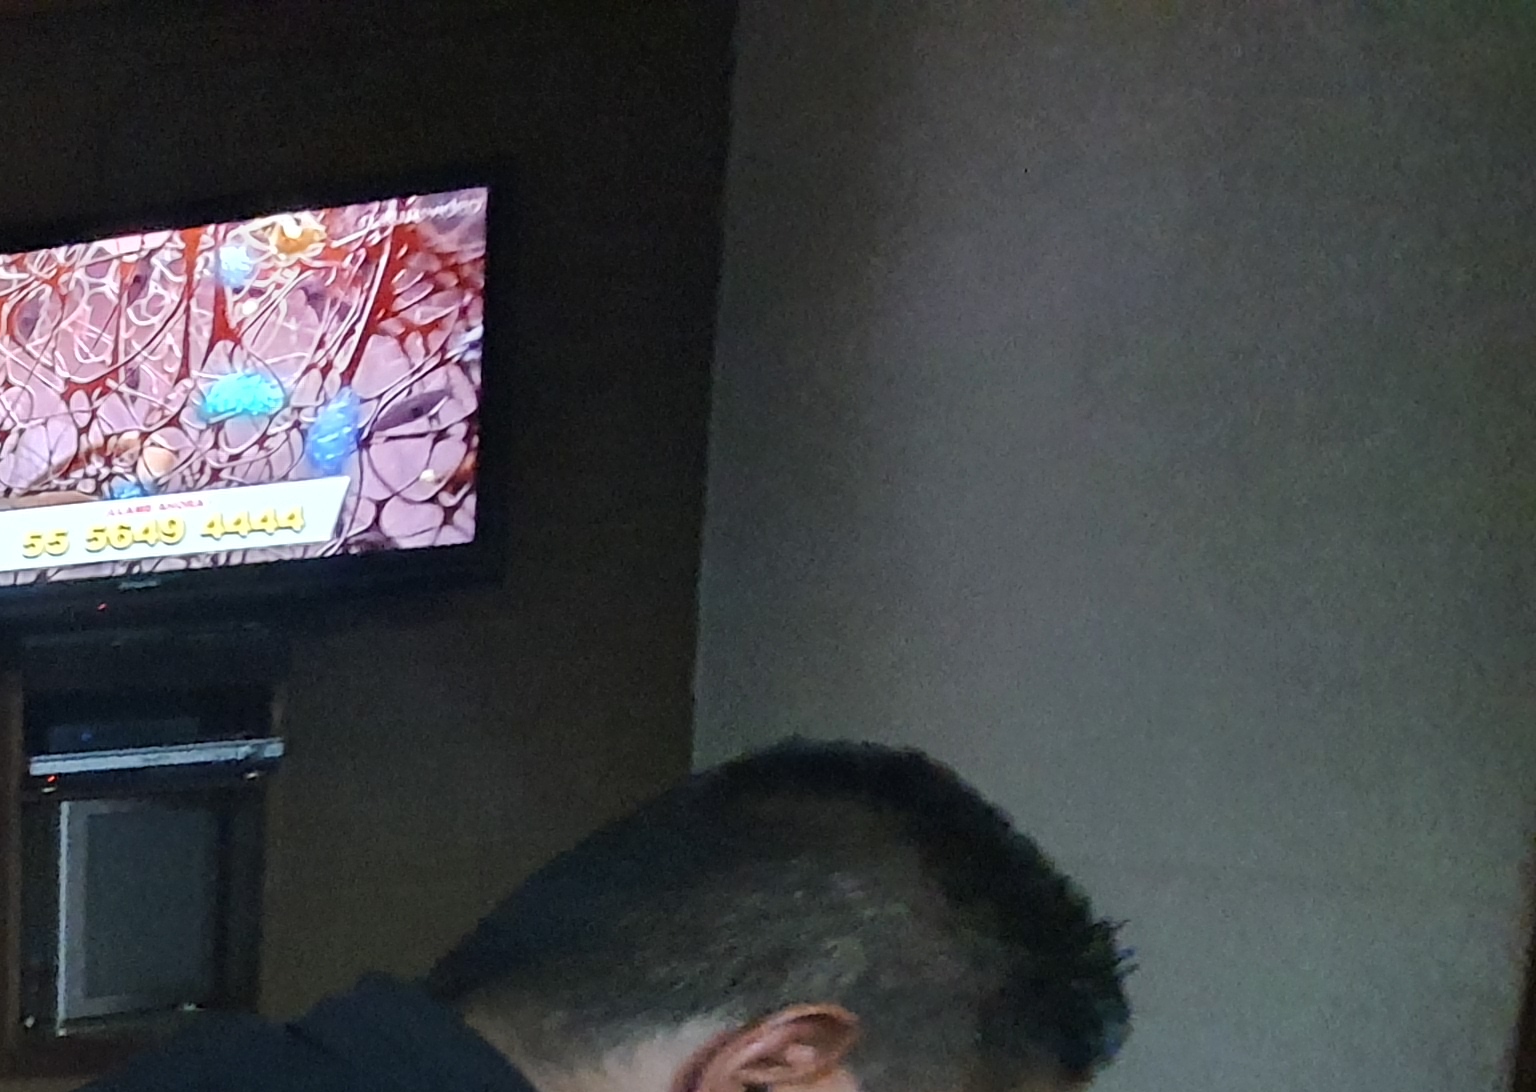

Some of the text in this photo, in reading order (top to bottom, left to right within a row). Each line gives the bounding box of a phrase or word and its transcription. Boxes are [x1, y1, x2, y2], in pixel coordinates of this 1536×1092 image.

[22, 504, 306, 559] 55 5649 4444
